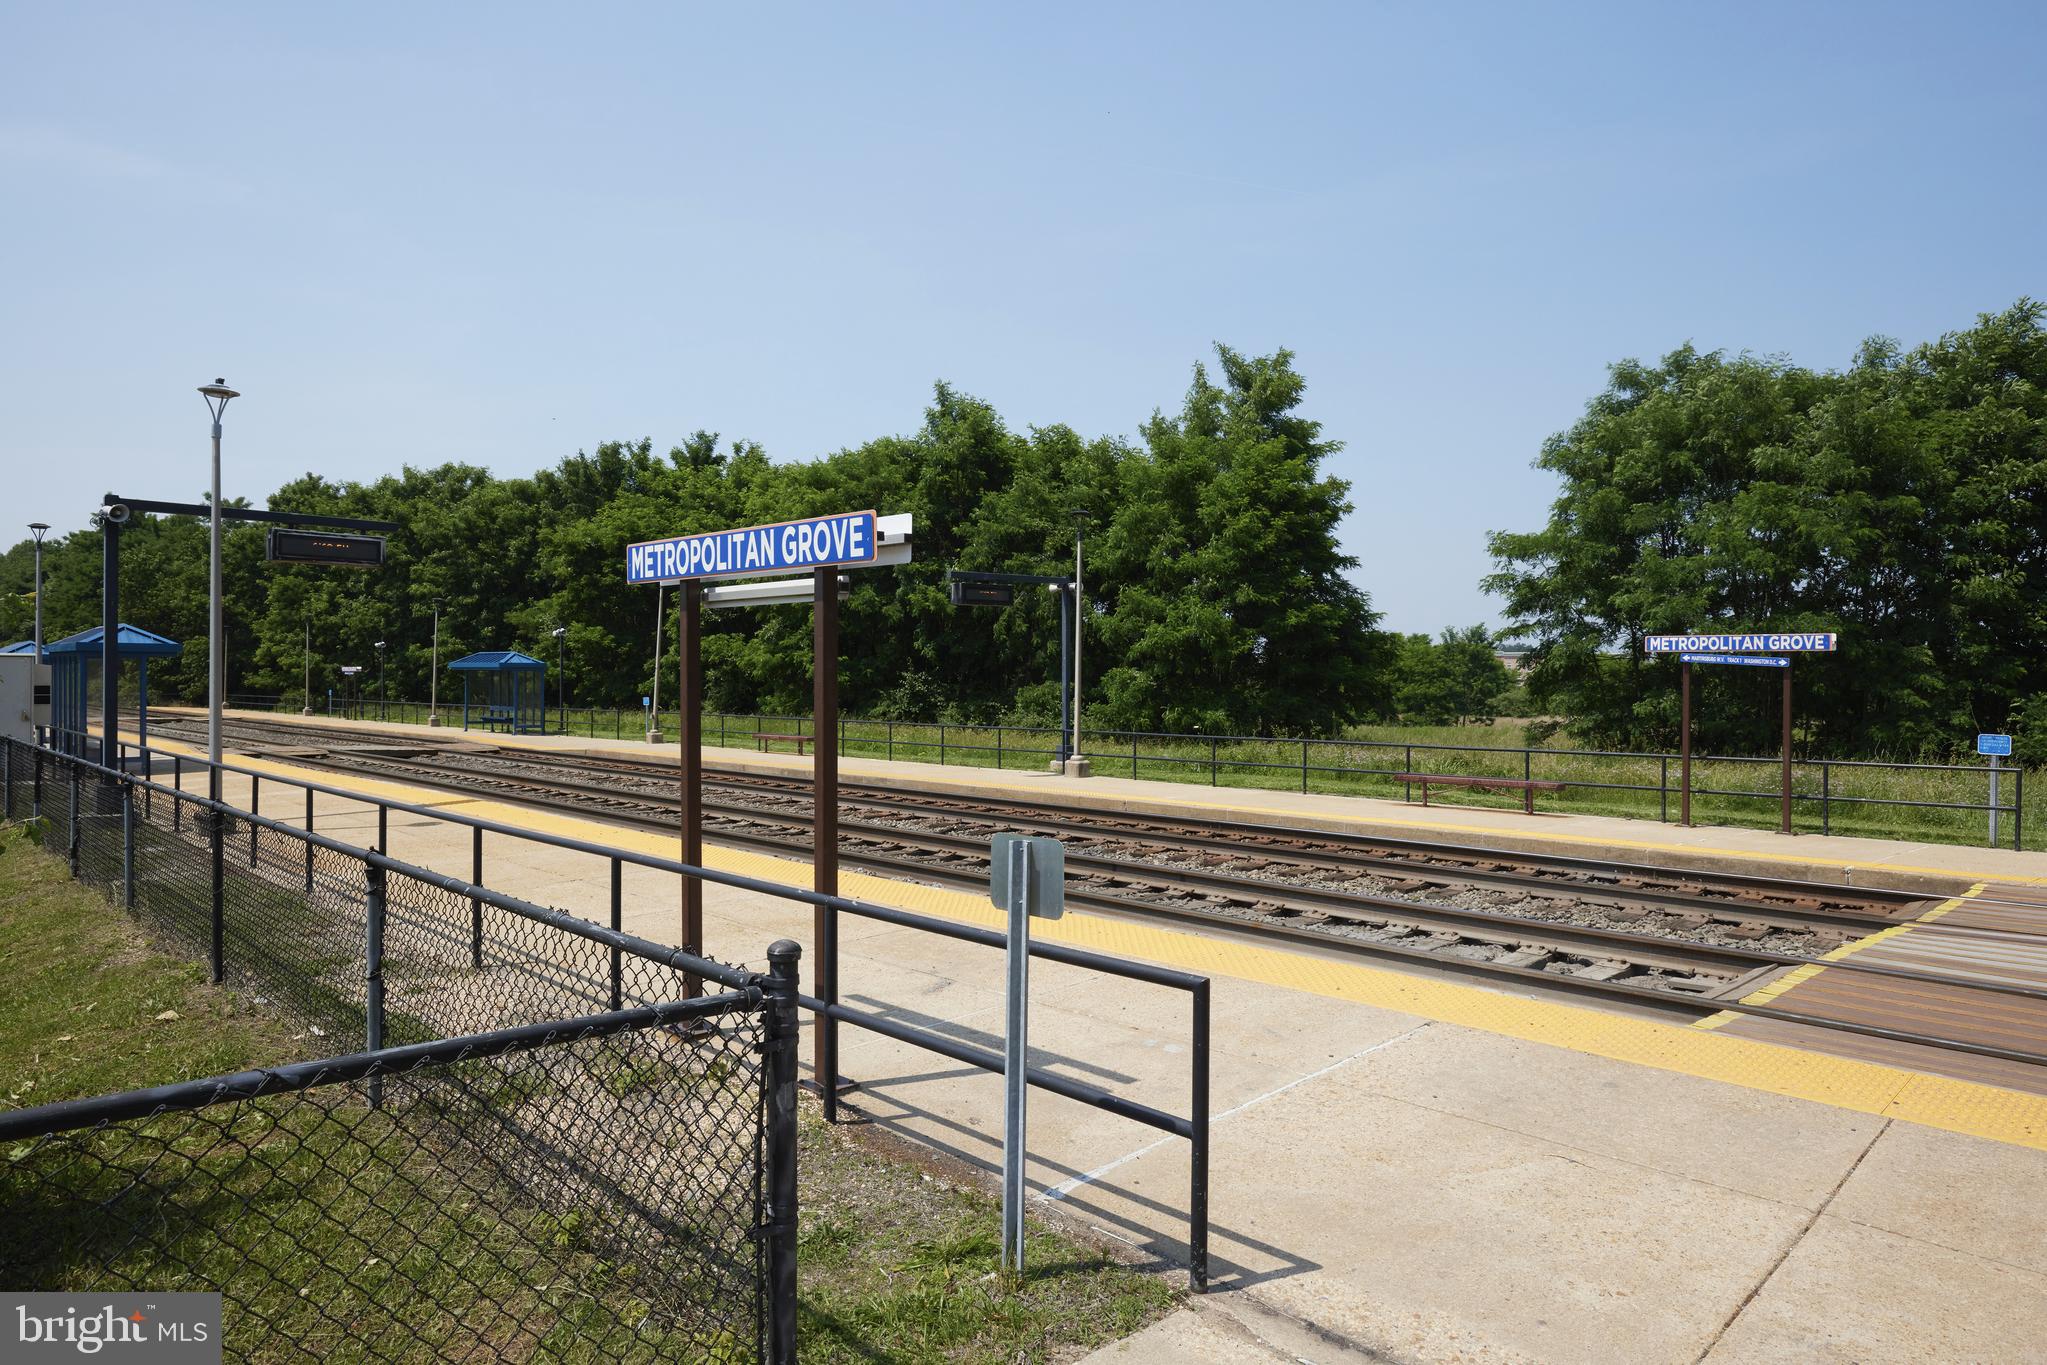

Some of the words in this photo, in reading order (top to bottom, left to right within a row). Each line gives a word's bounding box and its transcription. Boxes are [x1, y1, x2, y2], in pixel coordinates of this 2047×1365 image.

[631, 529, 775, 579] METROPOLITAN
[781, 516, 865, 564] GROVE
[1650, 636, 1764, 651] METROPOLITAN
[1768, 635, 1825, 650] GROVE
